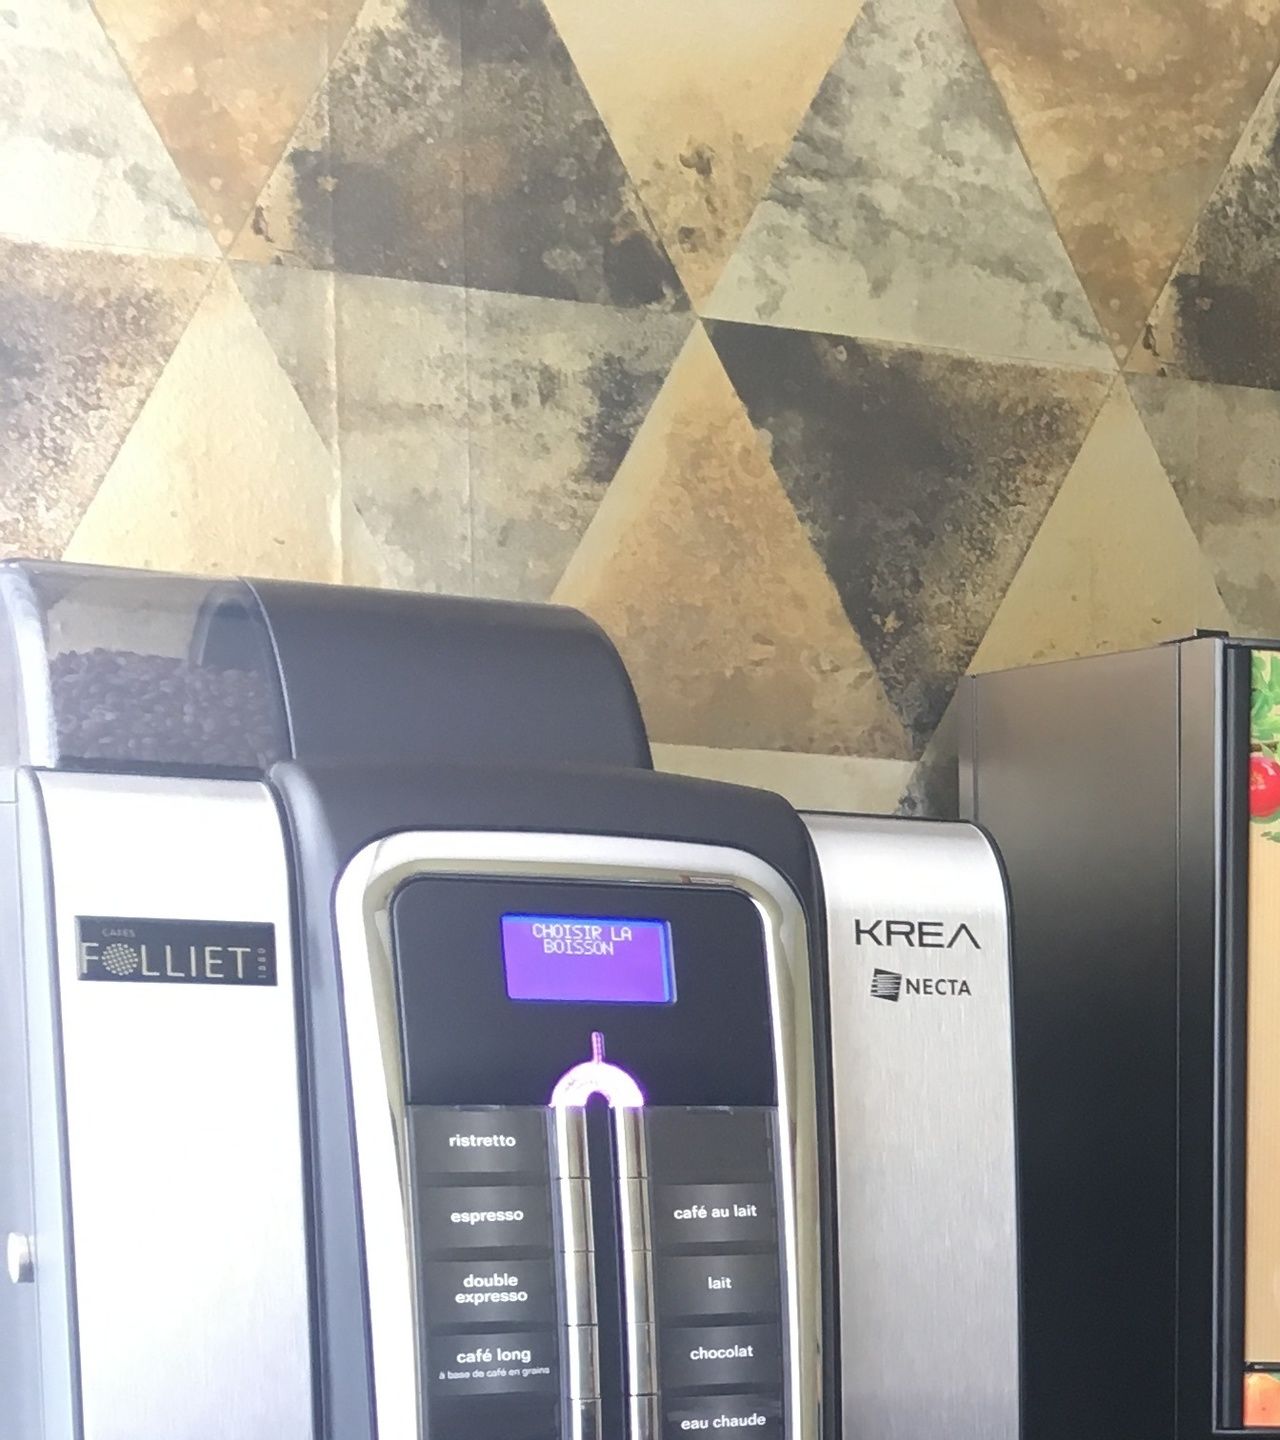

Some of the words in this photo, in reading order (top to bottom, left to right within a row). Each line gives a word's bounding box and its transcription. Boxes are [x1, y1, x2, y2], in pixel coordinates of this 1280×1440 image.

[532, 923, 602, 940] CHOISIR
[611, 926, 632, 941] LA
[543, 939, 614, 956] BOISSON
[905, 978, 972, 996] NECTA
[449, 1133, 517, 1148] ristretto
[450, 1210, 525, 1226] espresso
[673, 1204, 708, 1220] café
[711, 1206, 730, 1218] au
[733, 1203, 758, 1218] lait
[462, 1272, 519, 1288] double
[707, 1275, 732, 1290] lait
[454, 1291, 529, 1306] expresso
[456, 1347, 493, 1363] café
[496, 1347, 532, 1364] long
[689, 1344, 754, 1361] chocolat
[472, 1368, 485, 1378] de
[486, 1367, 507, 1378] café
[508, 1368, 520, 1377] en
[521, 1366, 551, 1378] grains
[680, 1418, 709, 1431] eau
[712, 1412, 767, 1429] chaude
